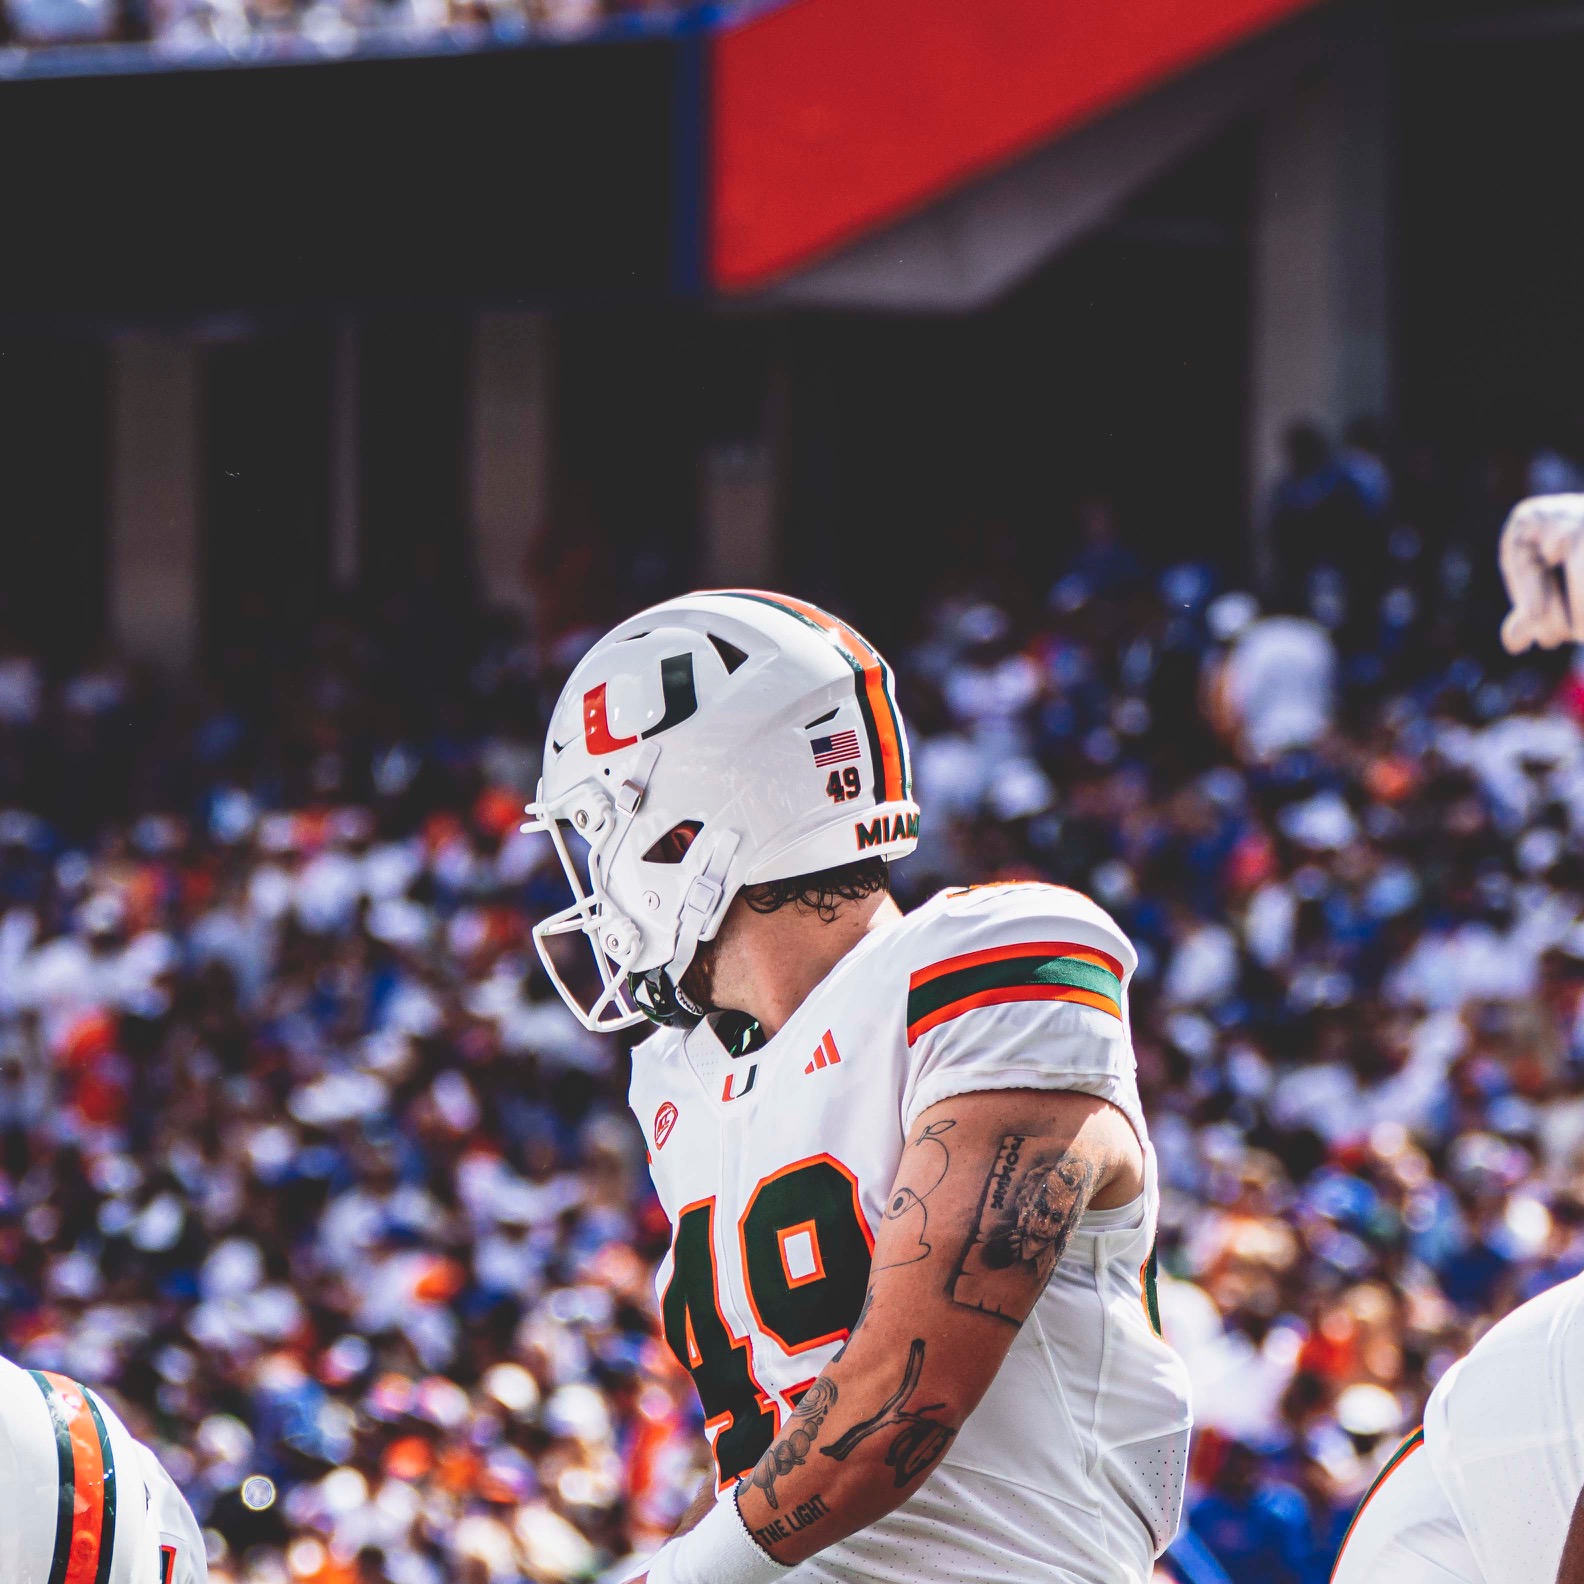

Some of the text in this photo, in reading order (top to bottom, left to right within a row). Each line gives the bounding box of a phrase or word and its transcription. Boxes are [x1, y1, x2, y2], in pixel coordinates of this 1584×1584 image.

[582, 652, 698, 756] U
[826, 766, 862, 804] 49
[855, 812, 920, 851] MIAM
[721, 1064, 758, 1102] U
[662, 1152, 876, 1492] 49
[756, 1494, 831, 1546] THE LIGHT
